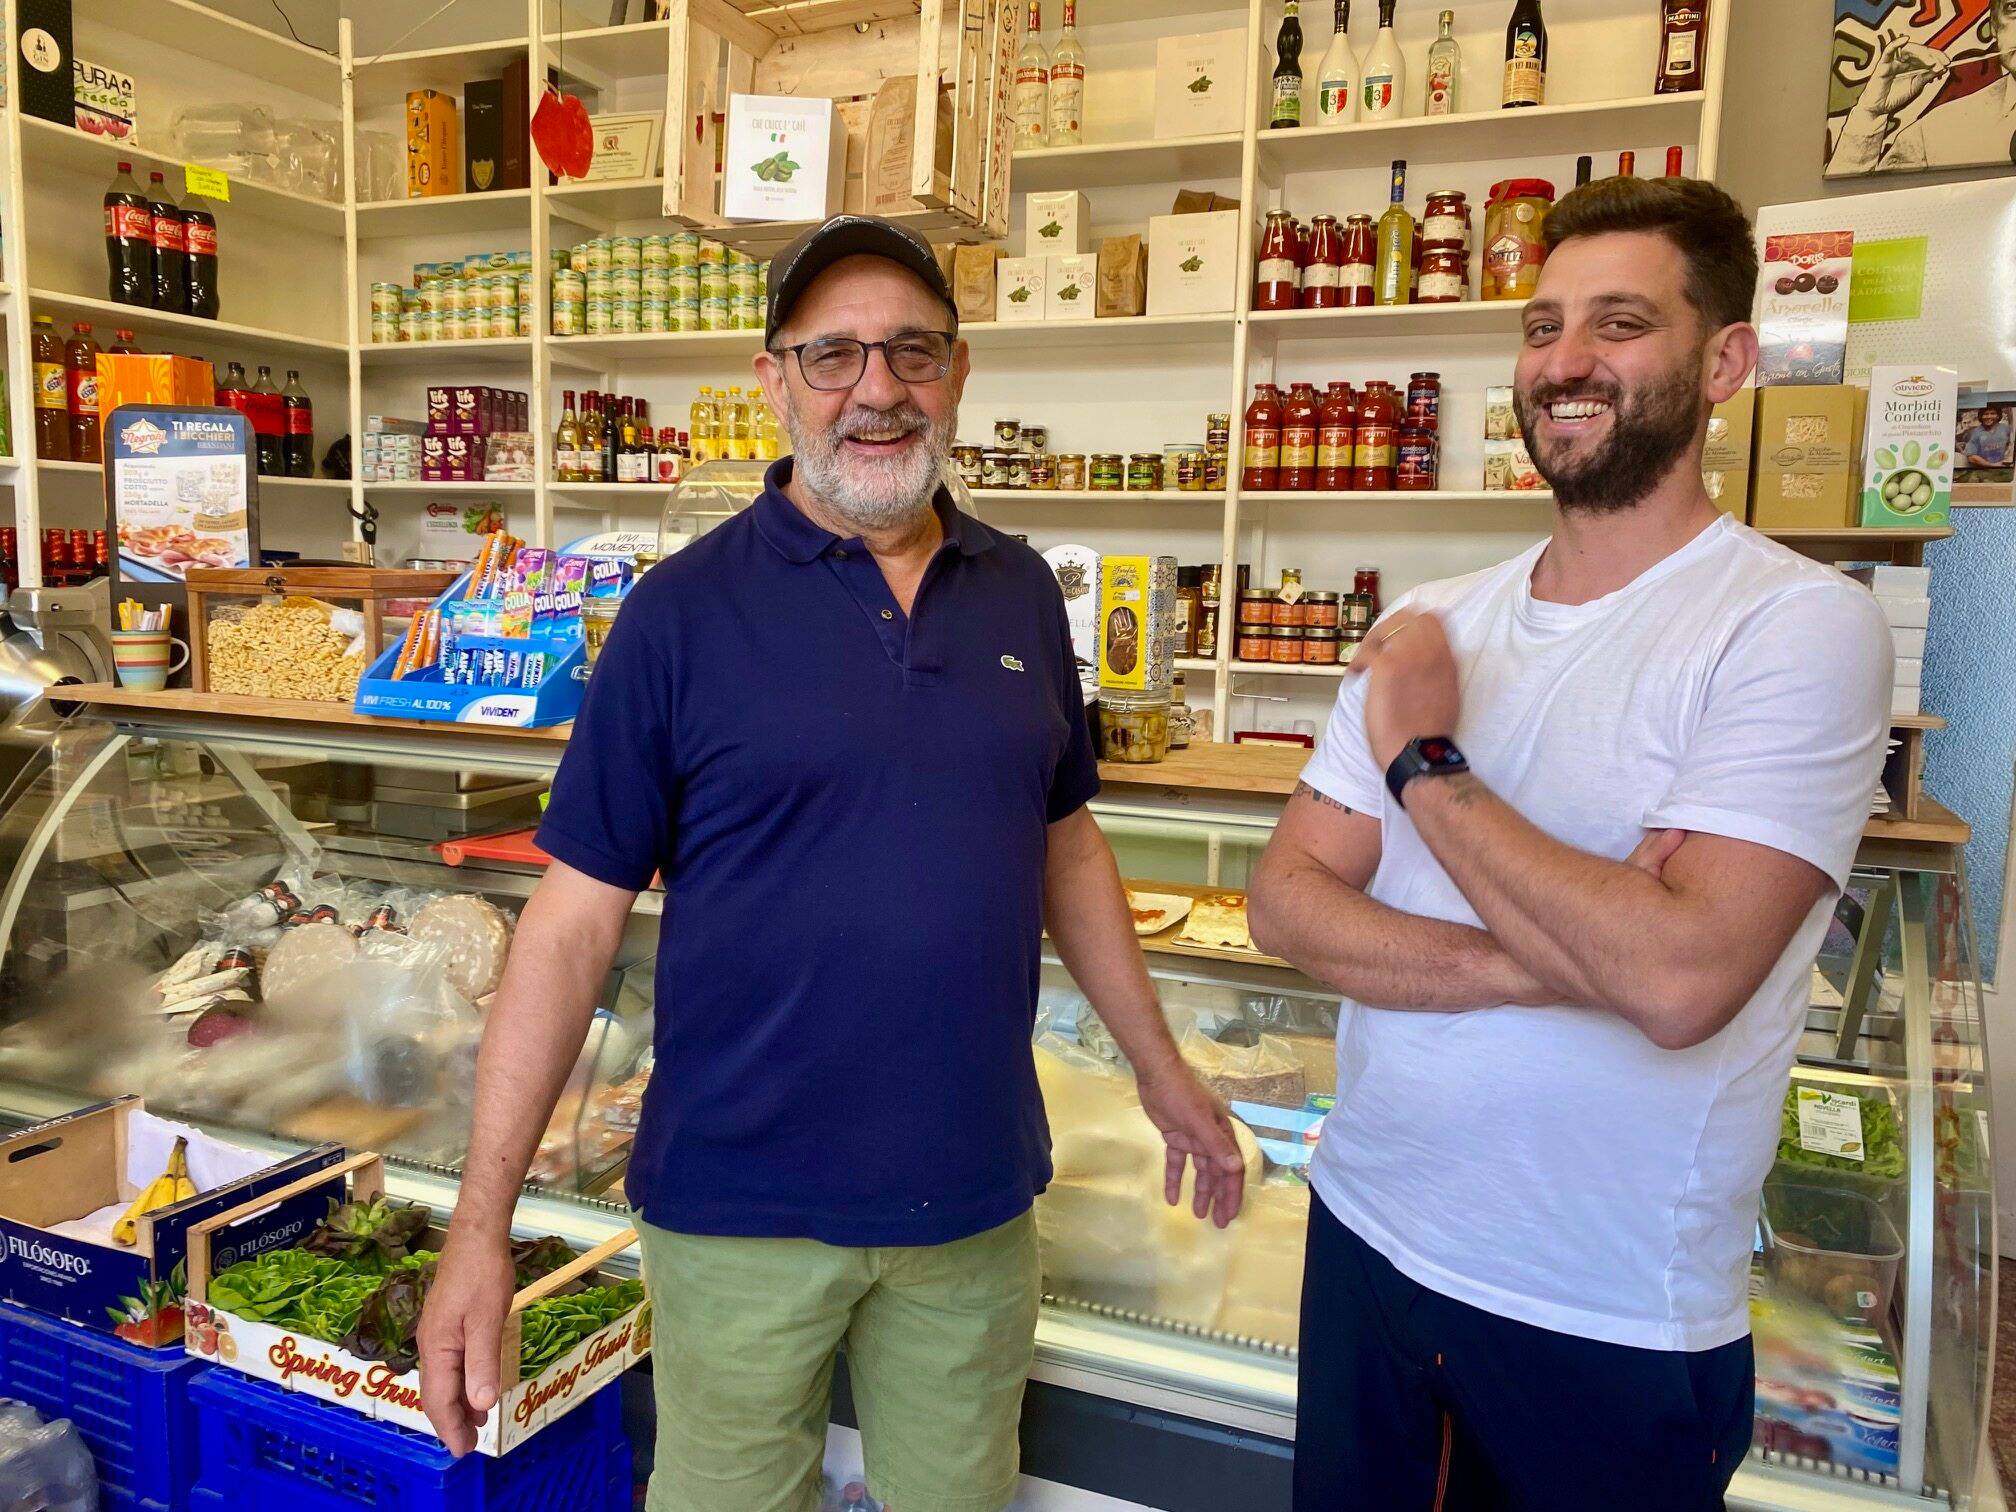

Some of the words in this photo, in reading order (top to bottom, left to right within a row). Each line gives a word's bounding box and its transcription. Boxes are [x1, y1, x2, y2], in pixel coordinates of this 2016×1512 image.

[1668, 12, 1699, 21] MARTINI
[1329, 94, 1337, 106] 3
[1373, 89, 1382, 102] 3
[1791, 252, 1825, 266] DORIS
[1850, 284, 1916, 297] RADIZIONE
[430, 389, 449, 403] life
[456, 389, 475, 403] life
[1885, 400, 1942, 412] Morbidi
[1884, 411, 1941, 423] Confetti
[172, 420, 184, 431] TI
[186, 421, 235, 433] REGALA
[180, 431, 235, 442] BICCHIERI
[1364, 430, 1387, 438] MUTTI
[424, 436, 443, 450] life
[447, 436, 466, 450] life
[616, 533, 640, 543] VIVI
[591, 542, 656, 553] MOMENTO
[534, 594, 554, 613] GOLI
[362, 694, 379, 705] VIVI
[379, 696, 412, 707] FRESH
[412, 699, 424, 710] AL
[425, 700, 452, 711] 100%
[480, 705, 520, 718] VIVIDENT
[240, 1220, 303, 1257] FILÓSOFO
[9, 1236, 88, 1276] FILÓSOFO
[268, 1336, 360, 1398] Spring
[513, 1362, 582, 1426] Spring
[582, 1321, 632, 1377] Fruit
